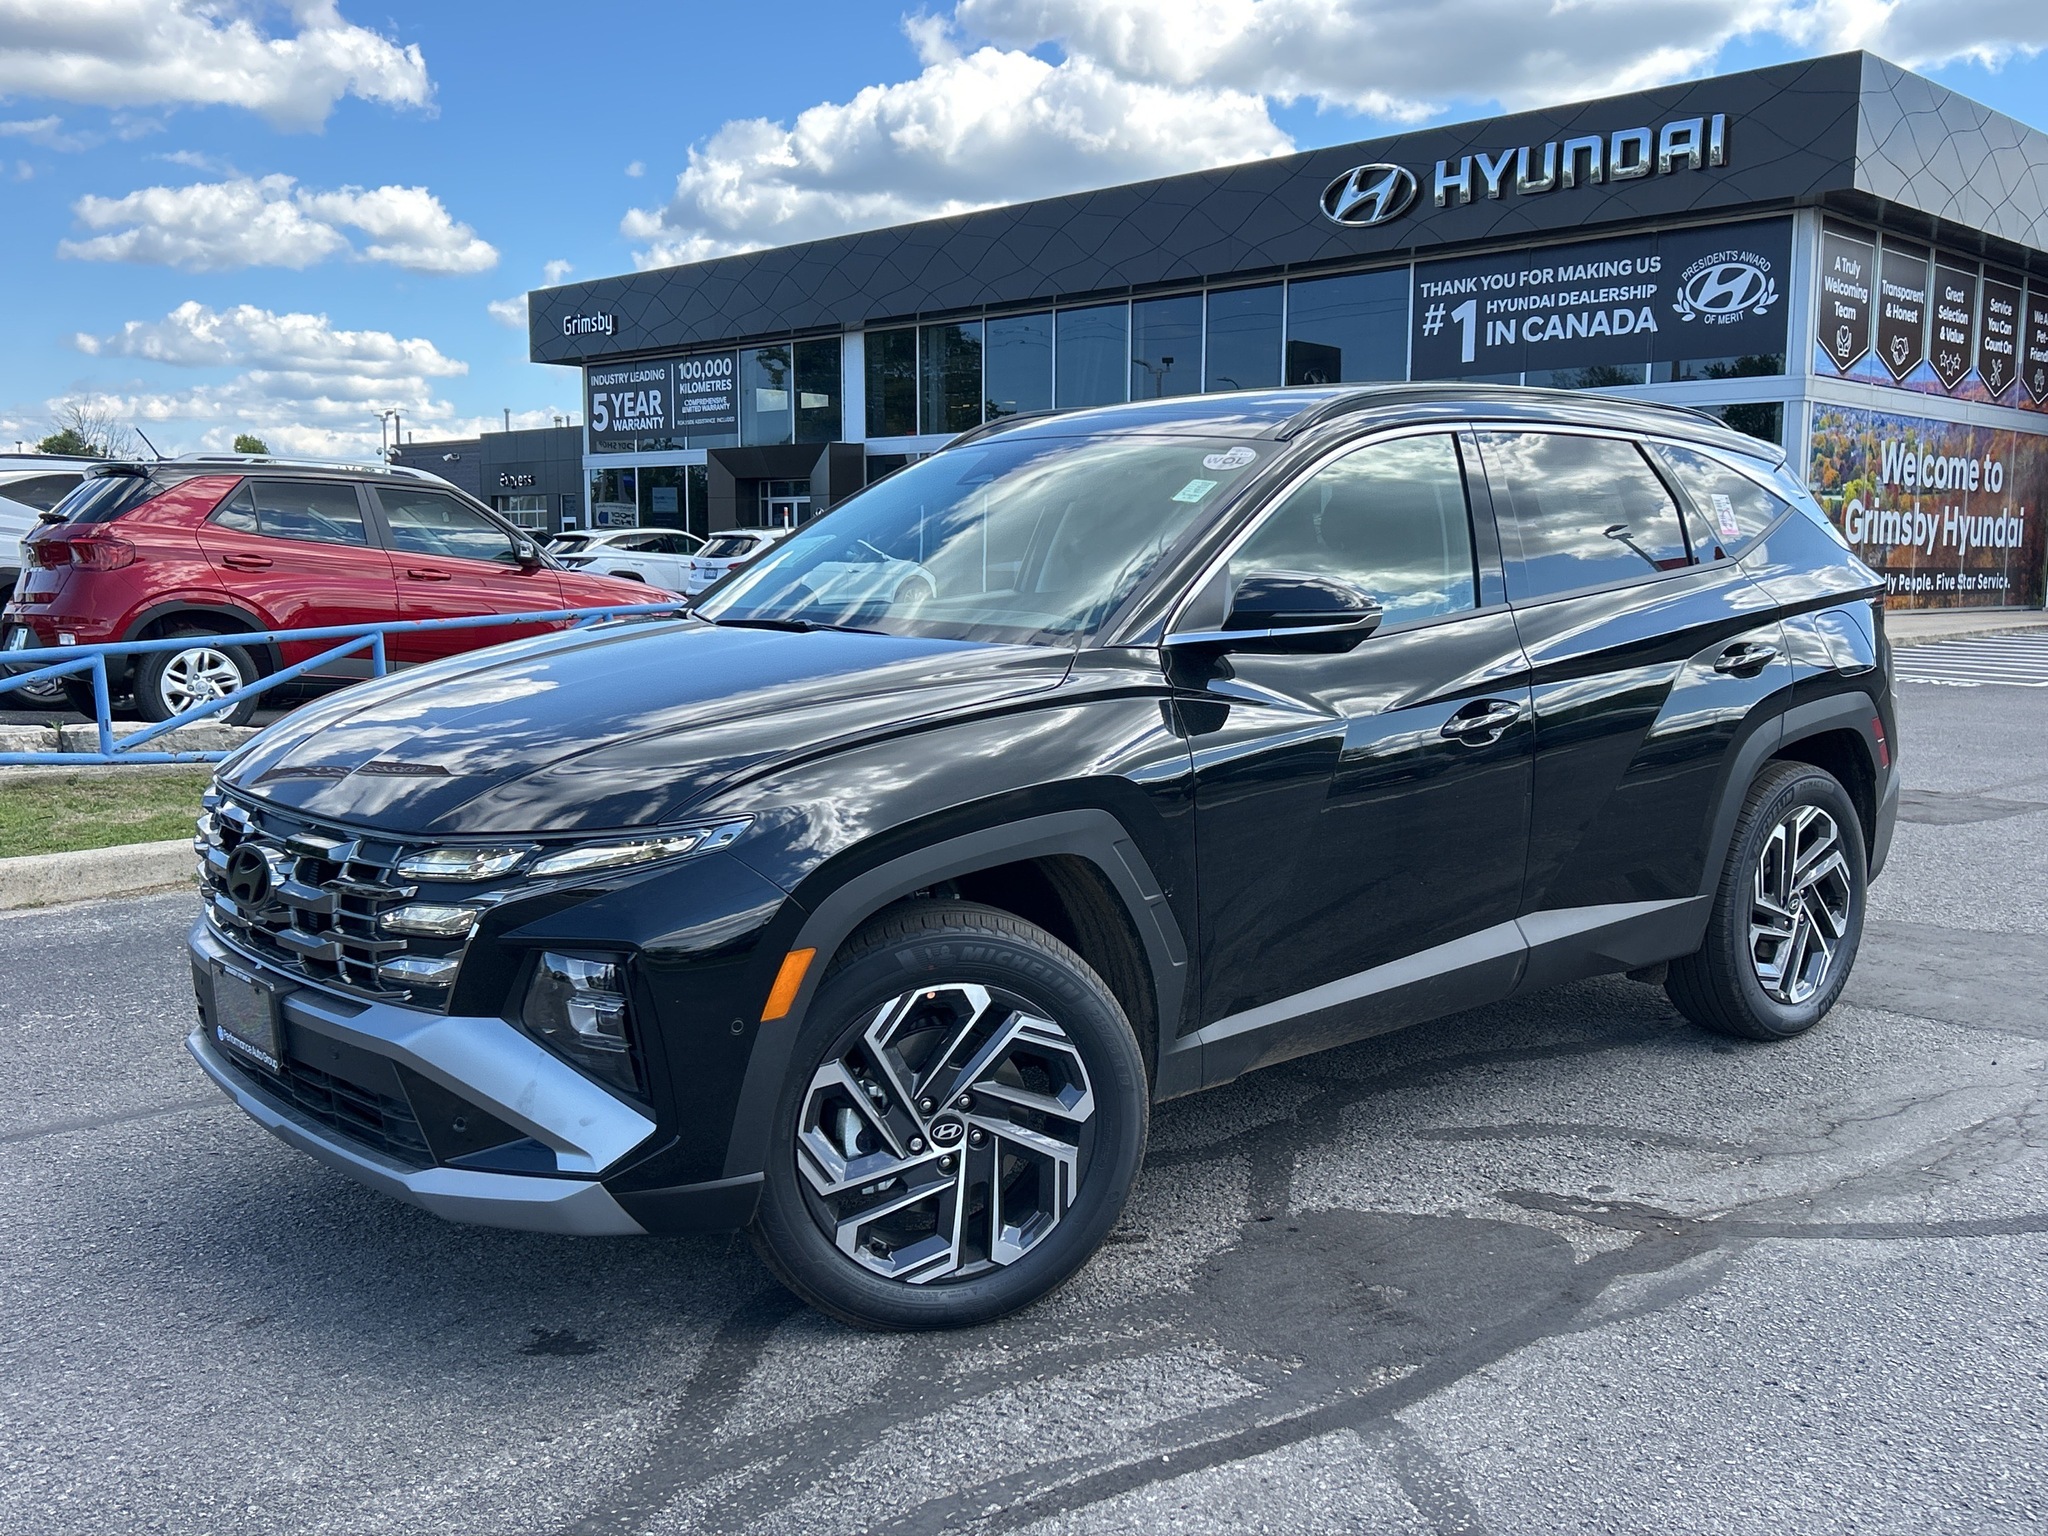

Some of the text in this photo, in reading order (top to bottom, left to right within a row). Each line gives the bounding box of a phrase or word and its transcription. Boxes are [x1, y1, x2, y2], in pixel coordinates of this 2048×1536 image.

[1434, 113, 1727, 208] HYUNDAI
[1739, 250, 1772, 273] AWARD
[1834, 256, 1861, 279] A Truly
[1420, 256, 1662, 298] THANK YOU FOR MAKING US
[1486, 284, 1658, 314] HYUNDAI DEALERSHIP
[1824, 276, 1868, 303] Welcoming
[1882, 280, 1924, 304] Transparent
[1945, 286, 1965, 304] Great
[1704, 311, 1744, 325] OF MERIT
[1834, 301, 1856, 321] Team
[1885, 303, 1918, 324] & Honest
[1938, 305, 1969, 325] Selection
[1990, 298, 2012, 316] Service
[563, 311, 614, 336] Grimsby
[1486, 306, 1659, 346] IN CANADA
[1988, 317, 2012, 336] You Can
[1946, 328, 1965, 344] Value
[1985, 337, 2012, 356] Count On
[591, 368, 665, 386] INDUSTRY LEADING
[679, 358, 732, 380] 100,000
[679, 379, 732, 395] KILOMETRES
[592, 392, 609, 432] 5
[610, 389, 663, 418] YEAR
[612, 416, 665, 432] WARRANTY
[1881, 440, 2003, 493] Welcome to
[1845, 498, 2025, 556] Grimsby Hyundai
[1899, 573, 1934, 594] People.
[1936, 573, 1956, 591] Five
[1957, 573, 1976, 590] Star
[1978, 572, 2011, 590] Service.
[960, 946, 1081, 999] MICHELIN
